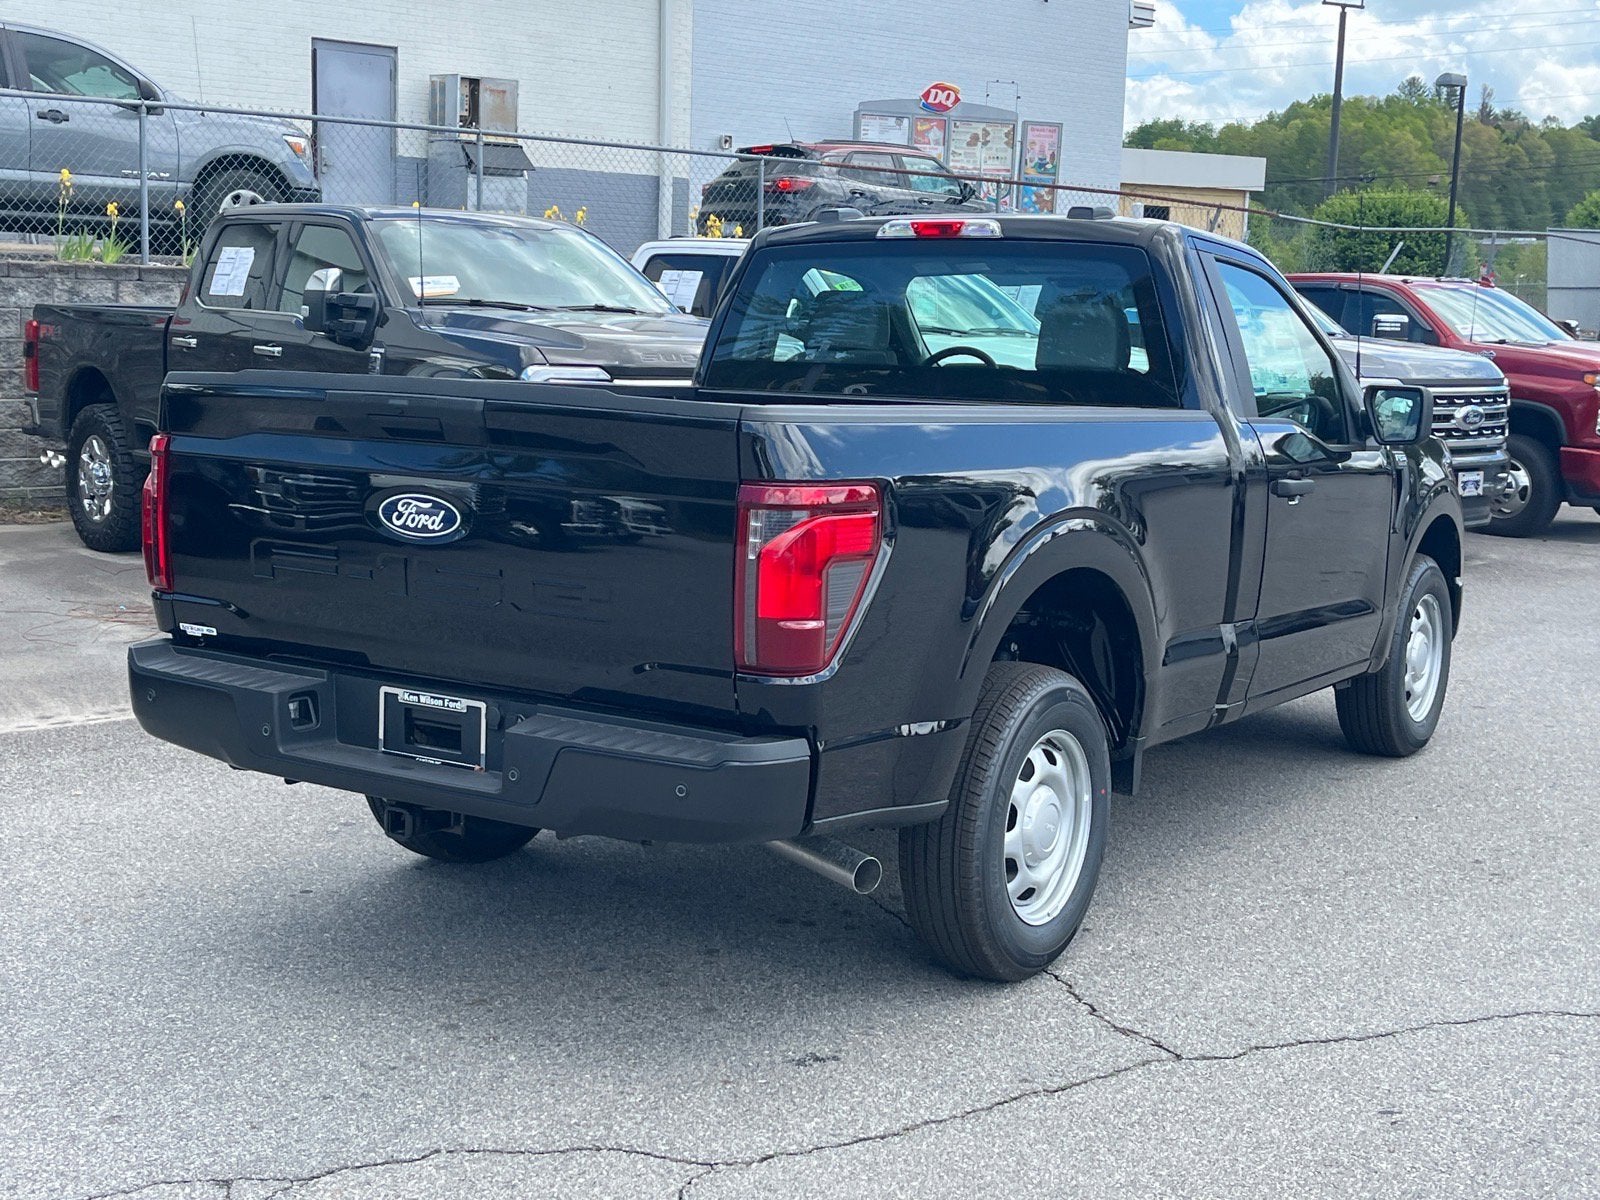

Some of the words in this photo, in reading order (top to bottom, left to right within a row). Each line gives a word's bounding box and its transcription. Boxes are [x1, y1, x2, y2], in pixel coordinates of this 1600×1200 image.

[928, 88, 954, 107] DQ
[121, 169, 170, 178] TIAN
[392, 499, 446, 530] Ford
[404, 692, 418, 702] Ken
[419, 695, 443, 706] Wilson
[444, 699, 461, 710] Ford
